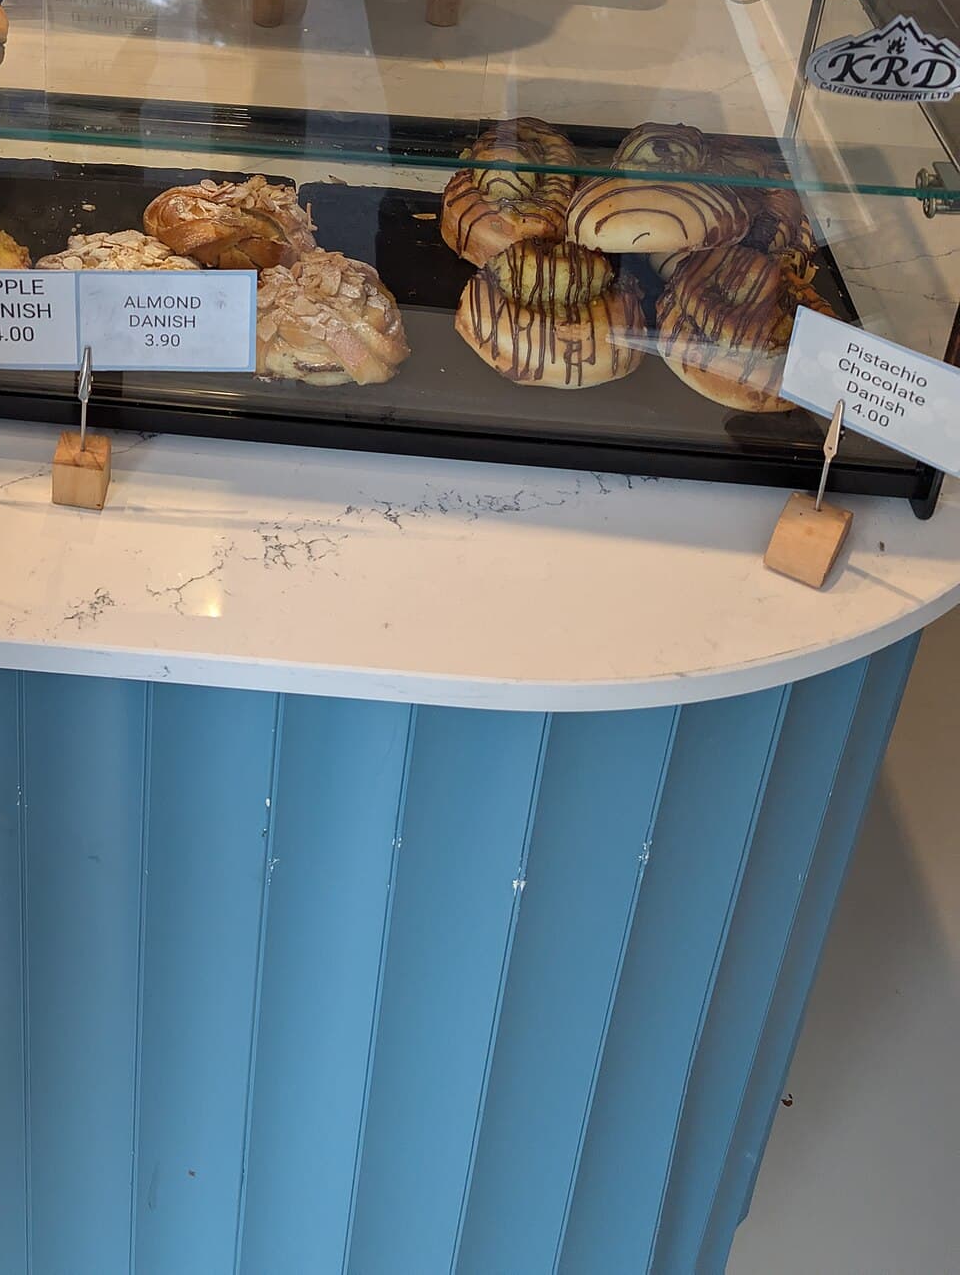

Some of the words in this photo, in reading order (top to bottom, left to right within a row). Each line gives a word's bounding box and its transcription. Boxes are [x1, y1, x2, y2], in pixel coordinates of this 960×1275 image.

[828, 52, 957, 89] KRD
[819, 81, 867, 99] CATERING
[870, 91, 928, 102] EQUIPMENT
[930, 91, 950, 100] LTD
[123, 295, 202, 310] ALMOND
[128, 314, 197, 329] DANISH
[143, 333, 181, 348] 3.90
[846, 342, 928, 388] Pistachio
[838, 357, 926, 407] Chocolate
[846, 380, 906, 417] Danish
[851, 403, 890, 427] 4.00
